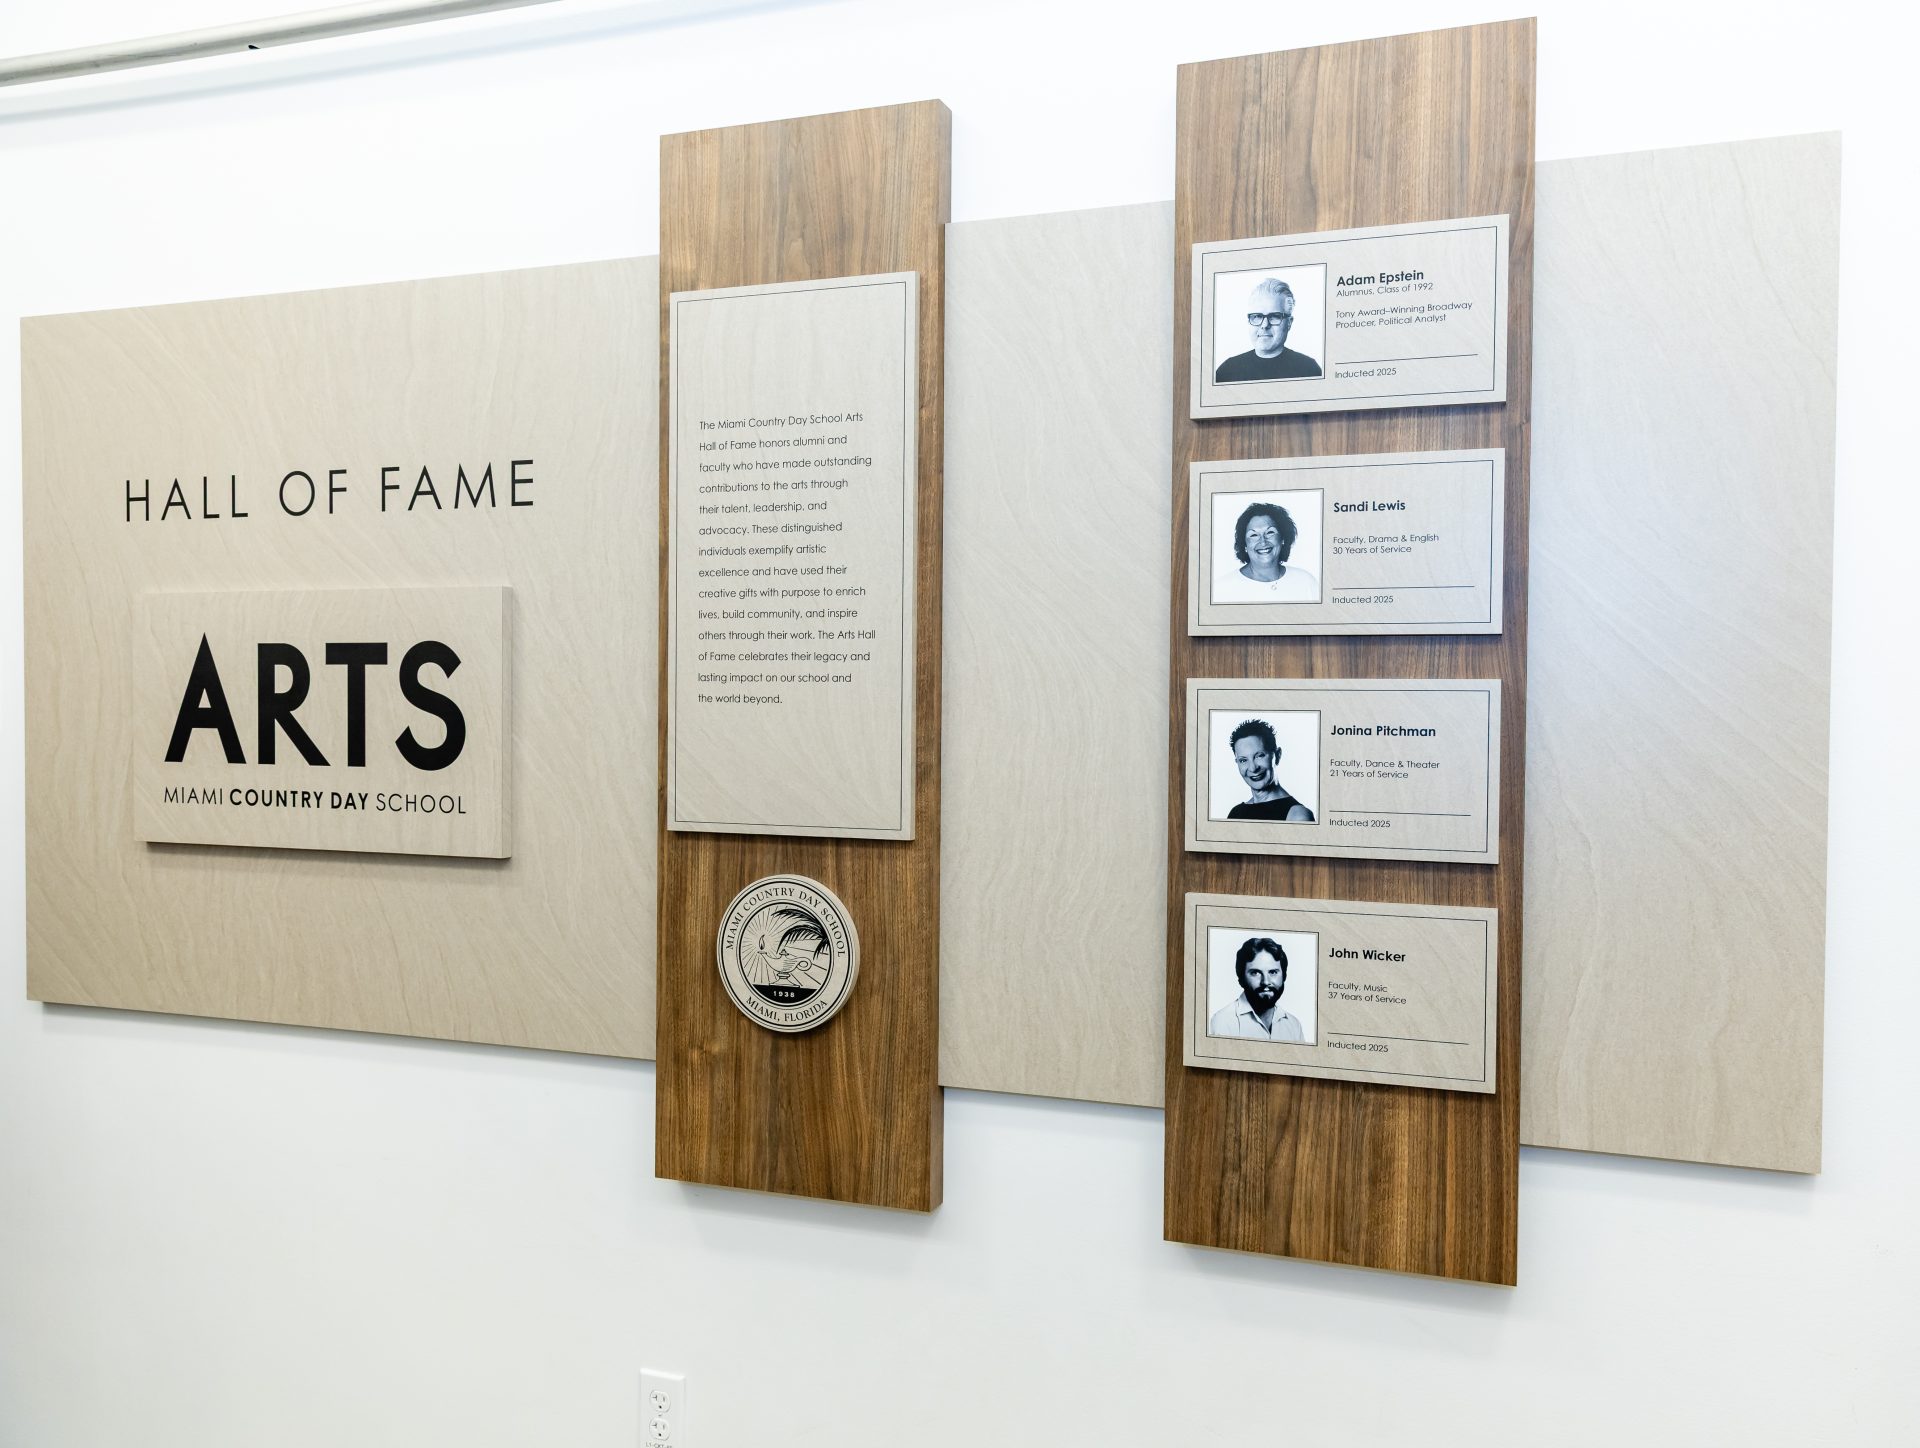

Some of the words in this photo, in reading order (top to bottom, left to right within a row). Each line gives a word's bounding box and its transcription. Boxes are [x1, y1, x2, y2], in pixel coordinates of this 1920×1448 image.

[1337, 274, 1375, 286] Adam
[1380, 270, 1424, 285] Epstein
[1336, 288, 1375, 297] Alumnus,
[1377, 285, 1399, 294] Class
[1401, 284, 1411, 292] of
[1414, 282, 1433, 291] 1992
[1336, 310, 1355, 319] Tony
[1428, 302, 1472, 311] Broadway
[1335, 319, 1376, 328] Producer,
[1379, 316, 1412, 326] Political
[1415, 314, 1446, 324] Analyst
[1335, 369, 1374, 379] Inducted
[1377, 368, 1397, 376] 2025
[700, 421, 715, 430] The
[718, 419, 746, 429] Miami
[748, 417, 785, 428] Country
[788, 416, 807, 425] Day
[810, 413, 843, 424] School
[845, 412, 863, 422] Arts
[700, 442, 716, 451] Hall
[719, 441, 730, 450] of
[731, 440, 756, 449] Fame
[759, 439, 790, 448] honors
[793, 436, 824, 446] alumni
[828, 435, 847, 444] and
[699, 463, 730, 473] faculty
[733, 462, 753, 470] who
[756, 460, 779, 470] have
[782, 459, 811, 468] made
[814, 456, 872, 468] outstanding
[126, 474, 248, 522] HALL
[279, 469, 347, 517] OF
[380, 459, 534, 513] FAME
[699, 483, 758, 494] contributions
[761, 482, 770, 491] to
[774, 481, 788, 490] the
[791, 480, 808, 490] arts
[811, 478, 848, 489] through
[699, 505, 719, 514] their
[722, 504, 750, 513] talent,
[754, 502, 805, 513] leadership,
[808, 501, 827, 511] and
[1333, 501, 1369, 512] Sandi
[1372, 500, 1406, 511] Lewis
[699, 526, 749, 536] advocacy.
[752, 524, 778, 534] These
[781, 522, 842, 534] distinguished
[1333, 536, 1366, 544] Faculty,
[1368, 535, 1398, 543] Drama
[1410, 533, 1439, 543] English
[699, 546, 746, 556] individuals
[749, 545, 793, 557] exemplify
[796, 545, 826, 554] artistic
[1345, 546, 1367, 554] Years
[1369, 546, 1378, 554] of
[1381, 545, 1412, 553] Service
[699, 568, 749, 577] excellence
[752, 567, 771, 576] and
[774, 567, 798, 575] have
[801, 566, 824, 575] used
[826, 565, 847, 574] their
[699, 589, 736, 598] creative
[739, 589, 757, 599] gifts
[759, 588, 779, 597] with
[781, 588, 820, 599] purpose
[823, 587, 833, 596] to
[835, 587, 866, 596] enrich
[1332, 596, 1371, 604] Inducted
[1374, 595, 1393, 603] 2025
[698, 610, 720, 619] lives,
[722, 609, 745, 619] build
[747, 609, 803, 620] community,
[805, 609, 825, 618] and
[827, 608, 858, 619] inspire
[698, 631, 726, 640] others
[729, 631, 765, 641] through
[767, 631, 787, 640] their
[790, 630, 815, 640] work.
[818, 630, 834, 639] The
[837, 630, 855, 639] Arts
[858, 630, 876, 639] Hall
[698, 652, 708, 661] of
[710, 652, 736, 661] Fame
[738, 652, 788, 661] celebrates
[791, 652, 811, 661] their
[814, 652, 847, 663] legacy
[850, 652, 870, 661] and
[698, 673, 727, 684] lasting
[730, 673, 763, 684] impact
[765, 674, 778, 682] on
[780, 674, 795, 682] our
[798, 673, 829, 683] school
[832, 673, 852, 683] and
[164, 632, 467, 771] ARTS
[698, 694, 713, 703] the
[715, 694, 741, 703] world
[743, 694, 783, 705] beyond.
[1331, 725, 1372, 736] Jonina
[1376, 726, 1436, 737] Pitchman
[1330, 759, 1363, 768] Faculty,
[1366, 760, 1395, 768] Dance
[1406, 761, 1440, 769] Theater
[1342, 770, 1364, 778] Years
[1366, 770, 1375, 778] of
[1377, 771, 1408, 779] Service
[164, 786, 224, 805] MIAMI
[229, 789, 324, 809] COUNTRY
[330, 792, 369, 810] DAY
[376, 793, 467, 814] SCHOOL
[1329, 819, 1368, 827] Inducted
[1371, 820, 1391, 828] 2025
[726, 912, 744, 950] MIAMI
[744, 887, 795, 911] COUNTRY
[798, 891, 821, 908] DAY
[821, 908, 846, 957] SCHOOL
[1329, 948, 1358, 959] John
[1362, 949, 1406, 962] Wicker
[1328, 982, 1361, 991] Faculty,
[1364, 984, 1388, 992] Music
[1340, 992, 1362, 1001] Years
[1364, 994, 1373, 1002] of
[1375, 995, 1407, 1004] Service
[746, 997, 780, 1022] MIAMI,
[784, 1000, 828, 1021] FLORIDA
[1327, 1041, 1366, 1051] Inducted
[1368, 1044, 1388, 1052] 2025
